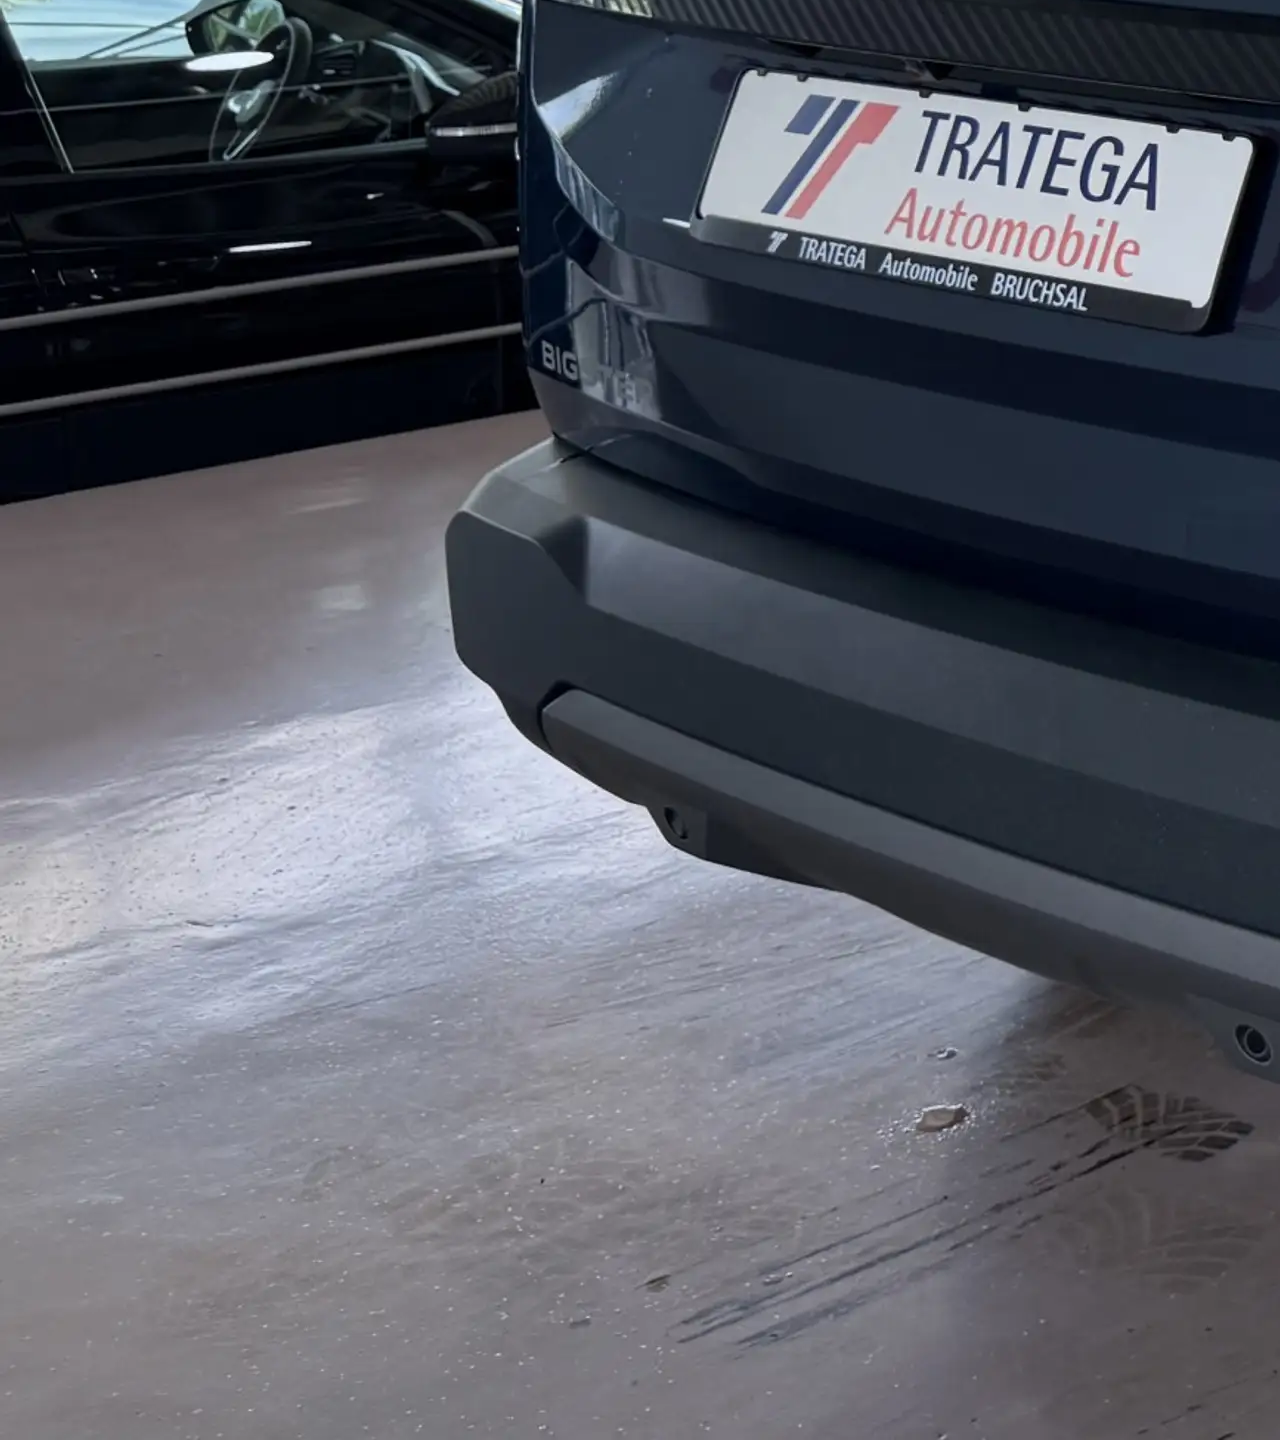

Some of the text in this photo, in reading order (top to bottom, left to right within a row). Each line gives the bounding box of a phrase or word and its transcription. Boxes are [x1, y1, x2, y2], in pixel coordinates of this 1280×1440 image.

[914, 109, 1160, 212] TRATEGA
[799, 236, 1090, 313] TRATEGA Automobile BRUCHSAL
[884, 187, 1142, 279] Automobile
